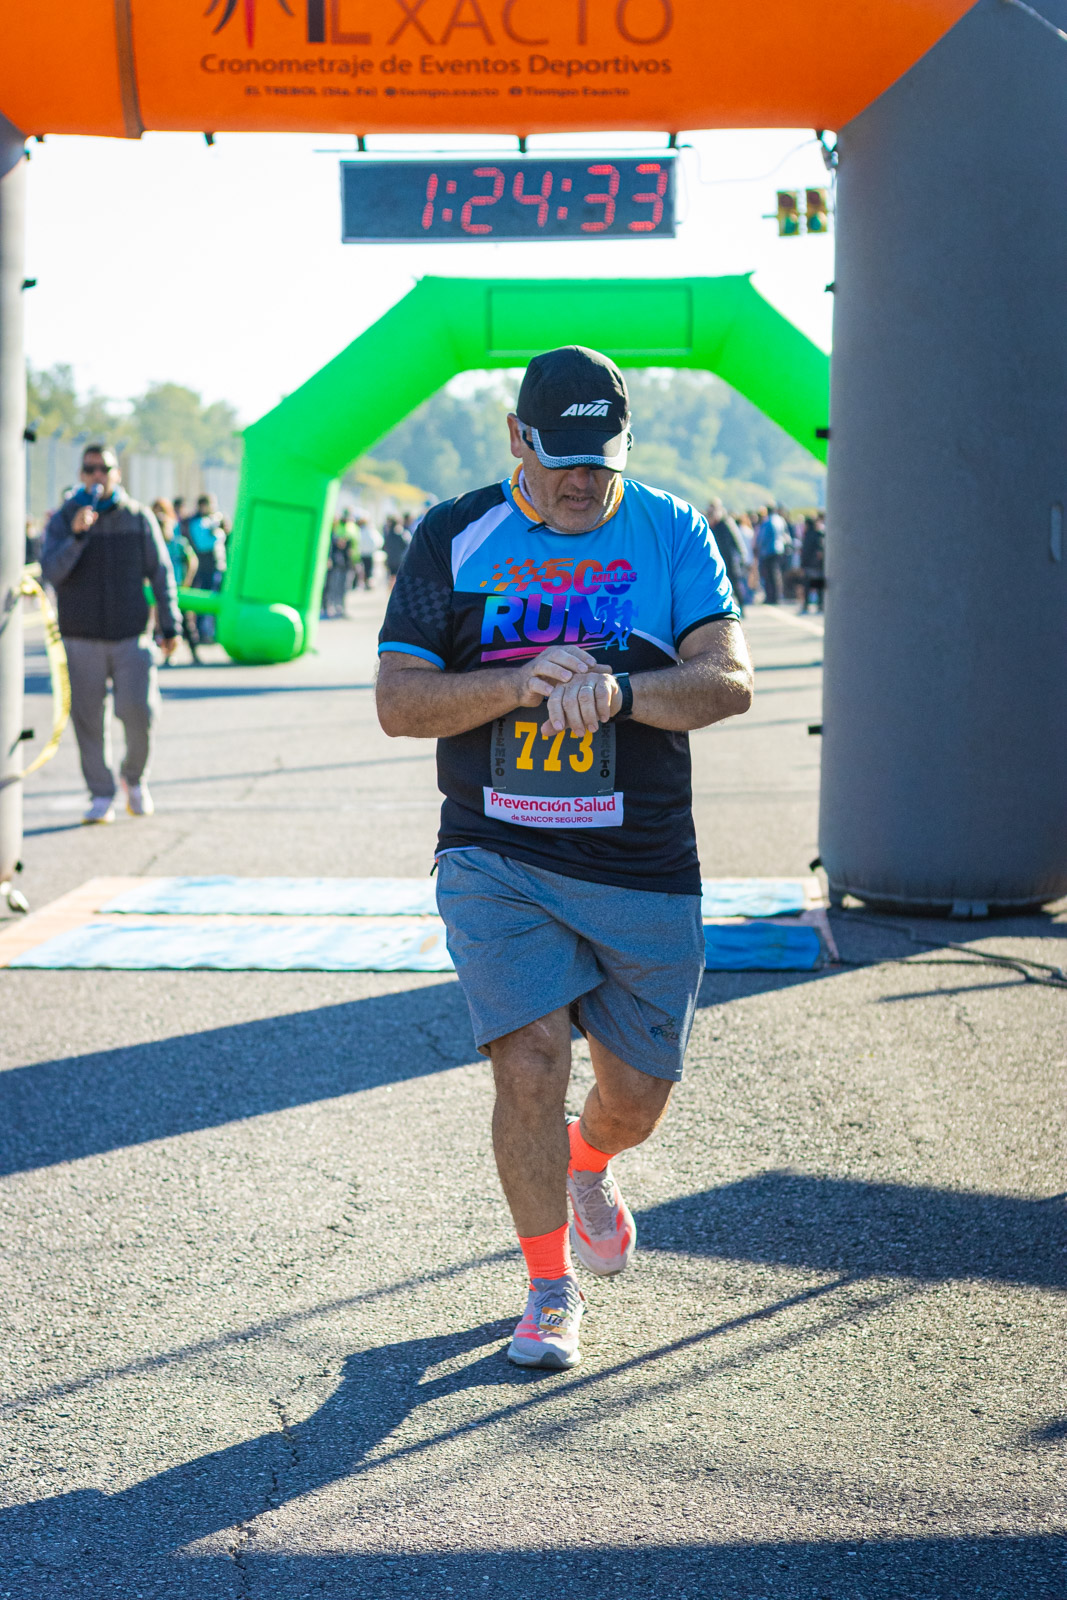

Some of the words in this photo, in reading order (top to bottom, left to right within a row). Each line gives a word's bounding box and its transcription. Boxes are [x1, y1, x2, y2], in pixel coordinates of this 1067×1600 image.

[200, 53, 374, 77] Cronometraje
[380, 54, 413, 74] de
[420, 54, 521, 75] Eventos
[528, 54, 672, 78] Deportivos
[422, 163, 669, 235] 1:24:33
[560, 399, 612, 417] AVIA
[541, 558, 632, 595] 500
[591, 572, 638, 583] MILLAS
[480, 593, 618, 645] RUN
[514, 721, 594, 773] 773
[490, 792, 571, 812] Prevención
[574, 797, 616, 812] Salud
[511, 814, 519, 822] de
[521, 815, 553, 823] SANCOR
